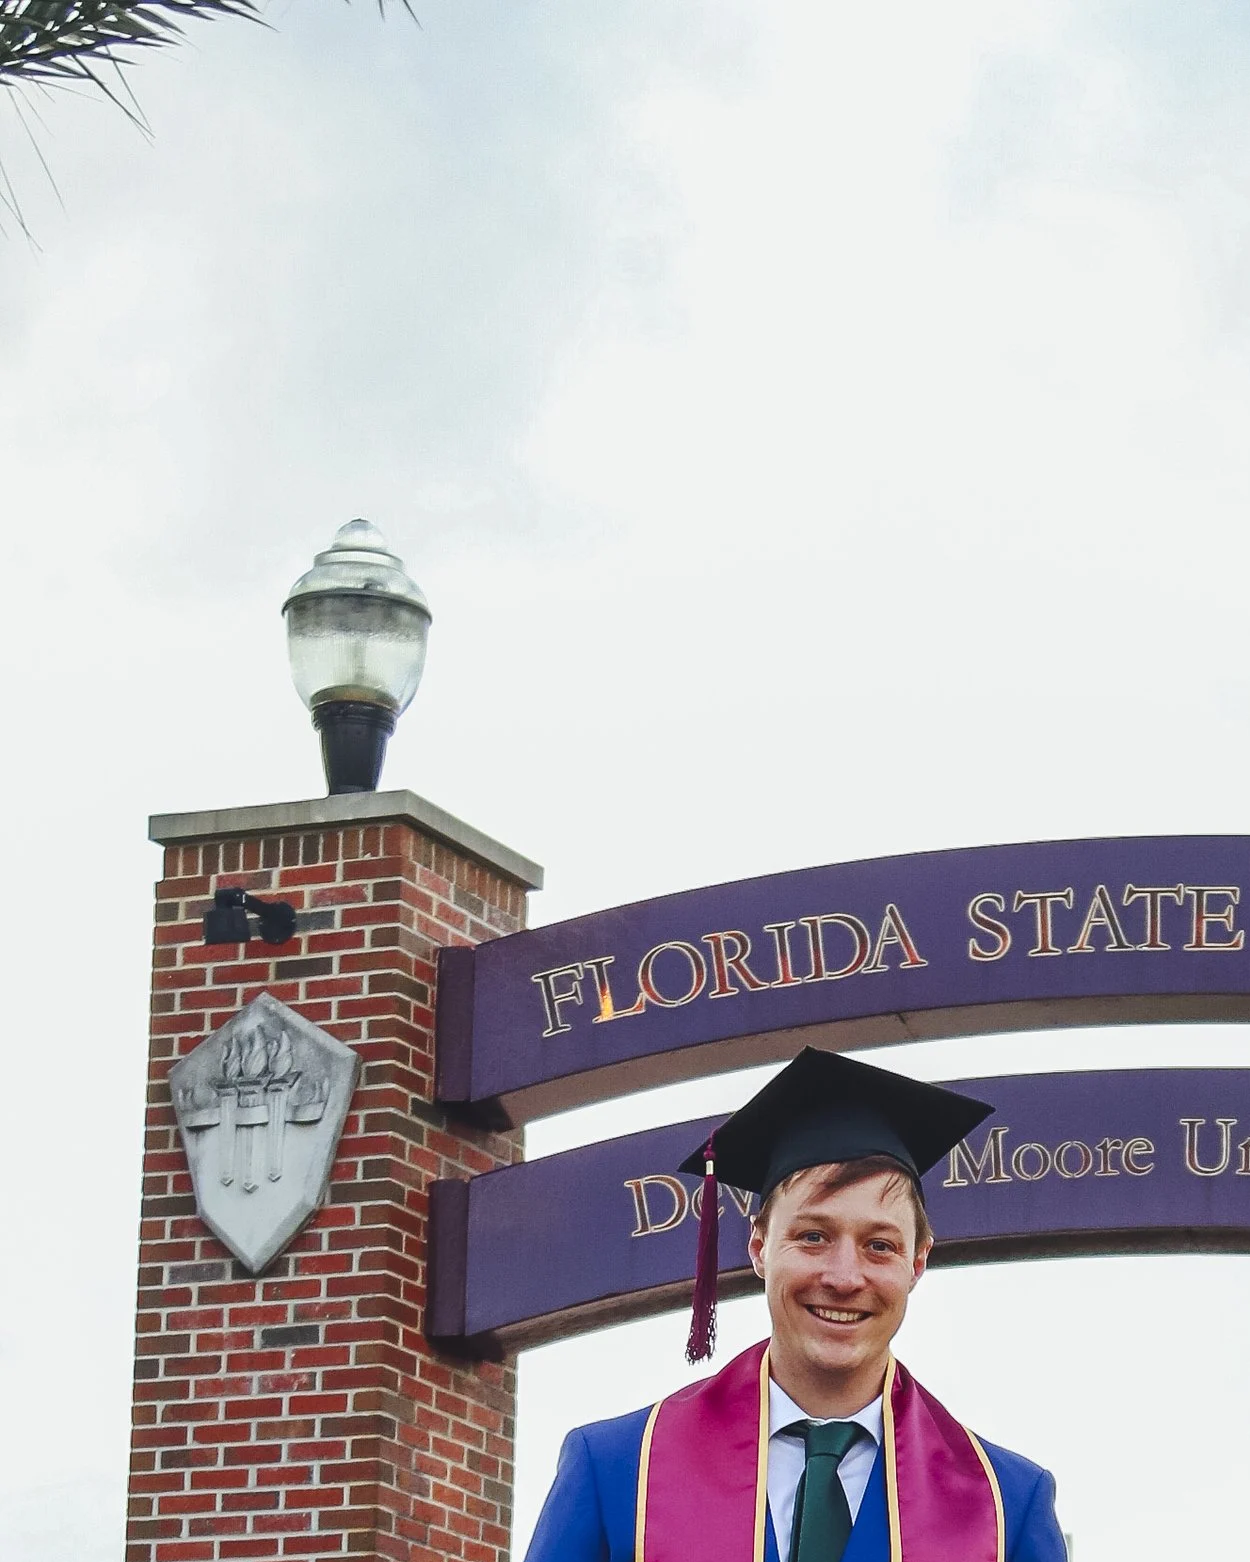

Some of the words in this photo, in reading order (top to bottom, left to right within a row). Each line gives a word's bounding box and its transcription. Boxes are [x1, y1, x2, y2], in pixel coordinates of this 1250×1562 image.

[532, 904, 927, 1037] FLORIDA
[968, 884, 1244, 961] STATE
[943, 1126, 1154, 1187] Moore
